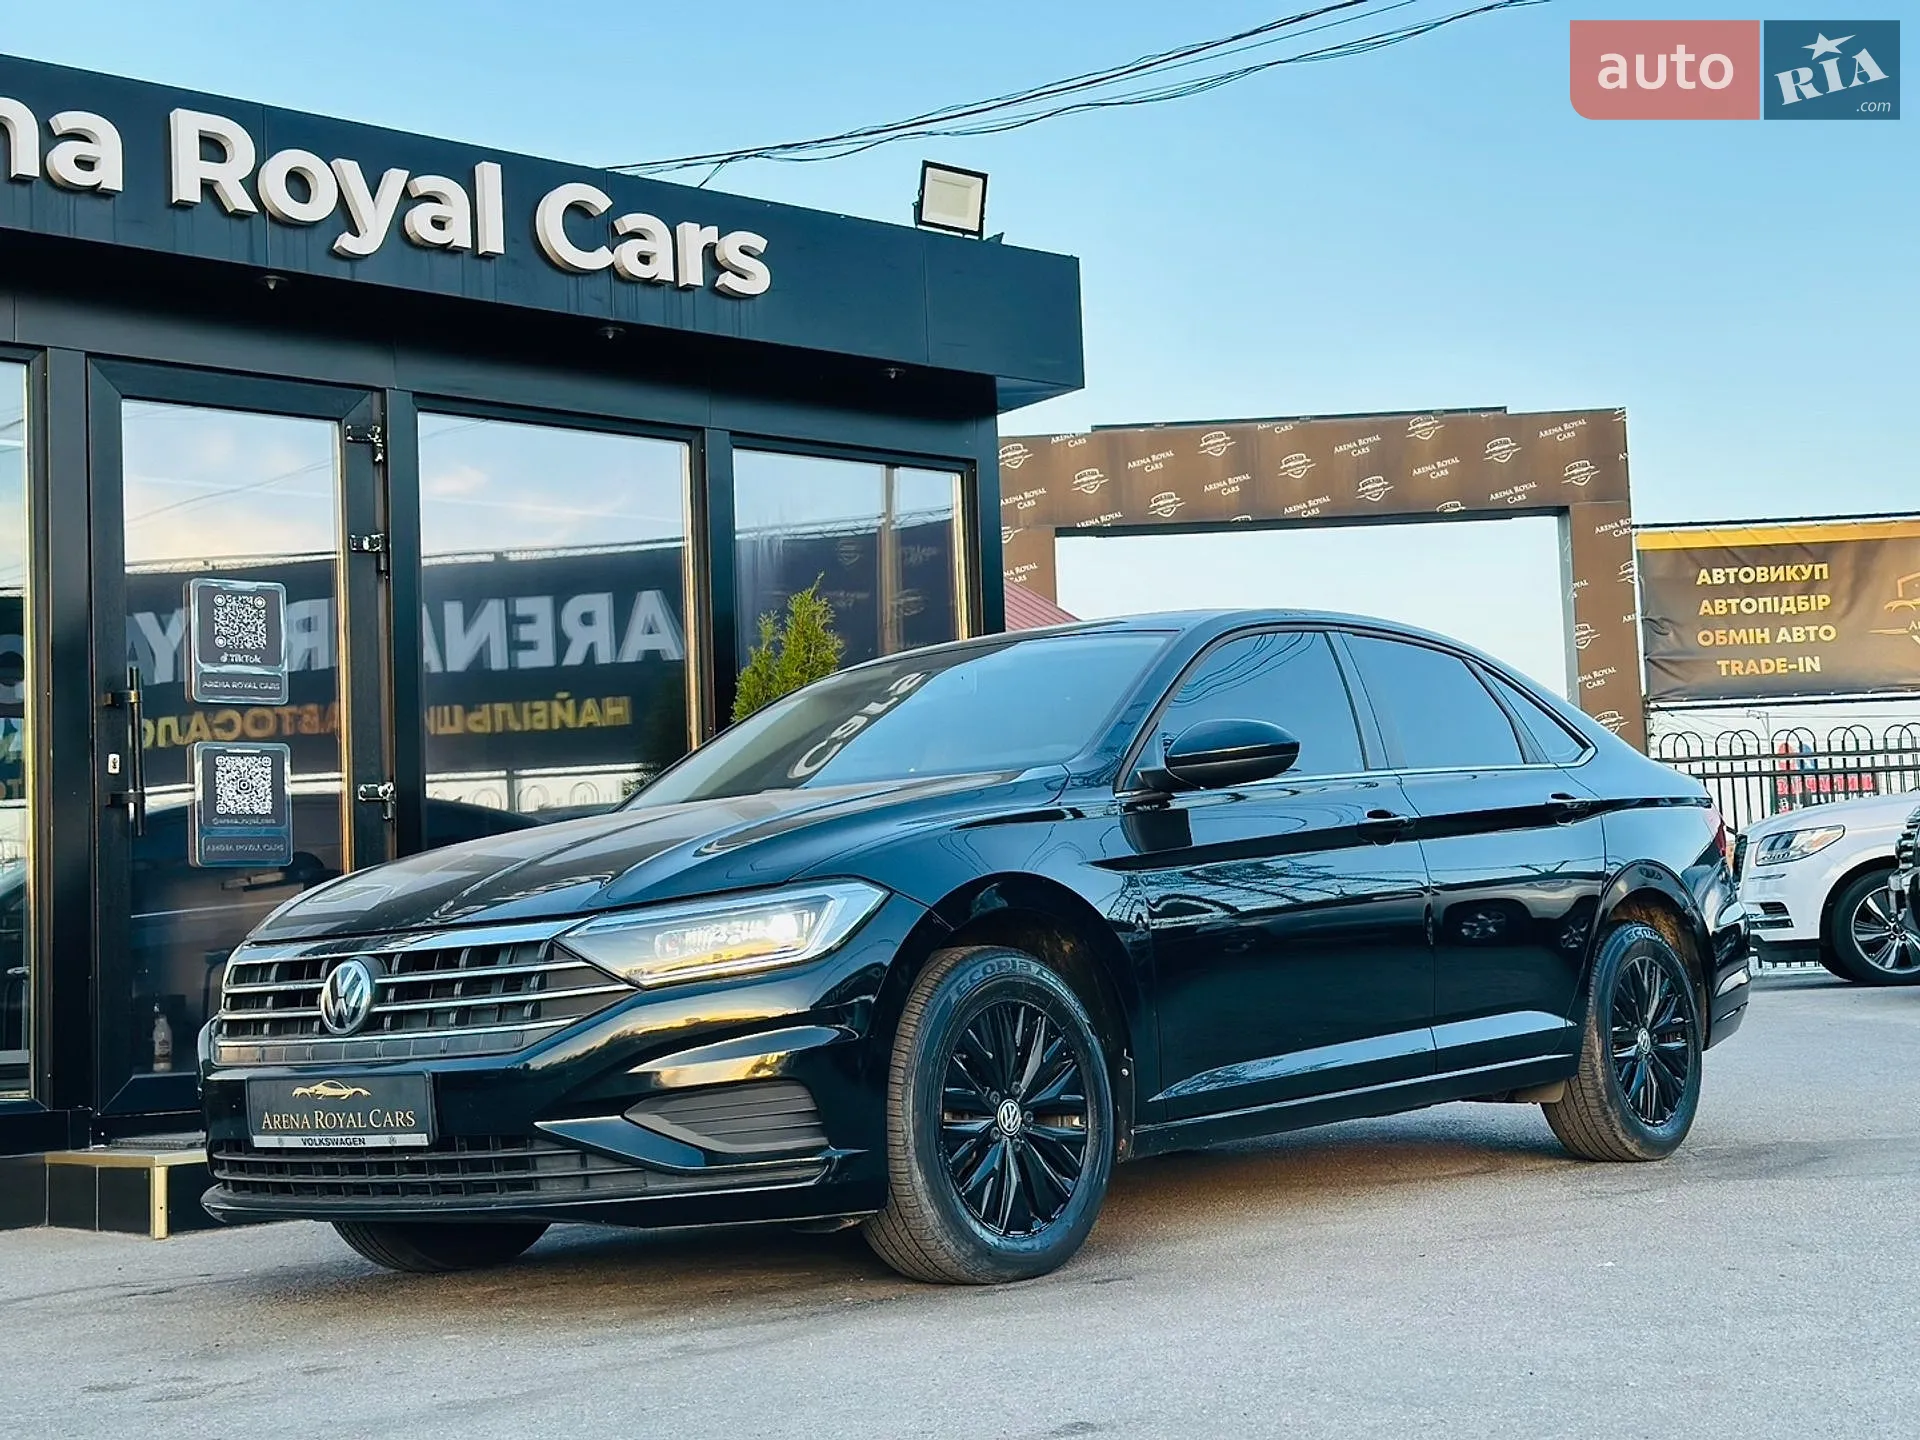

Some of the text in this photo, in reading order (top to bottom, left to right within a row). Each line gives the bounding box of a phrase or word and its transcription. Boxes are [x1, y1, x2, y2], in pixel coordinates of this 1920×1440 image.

[168, 107, 505, 259] Royal
[535, 181, 772, 298] Cars
[1696, 563, 1830, 585] АВТОВИКУП
[1699, 594, 1831, 616] АВТОПІДБІР
[1697, 625, 1837, 647] ОБМІН АВТО
[1716, 656, 1822, 676] TRADE-IN
[262, 1109, 416, 1130] ARENA ROYAL CARS
[301, 1137, 366, 1147] VOLKSWAGEN
